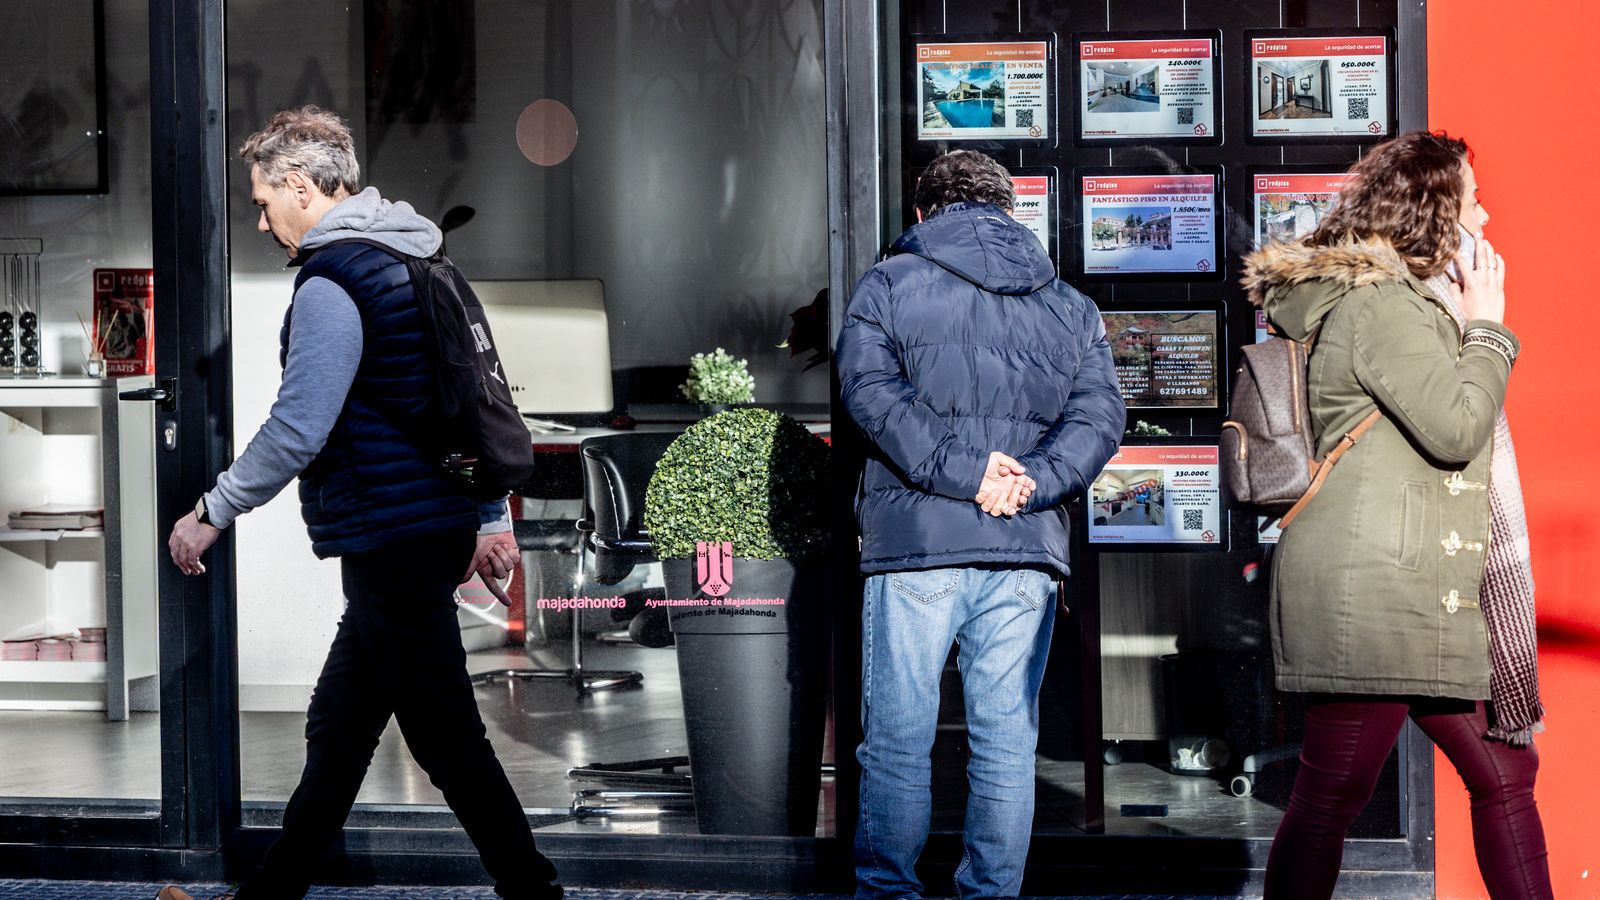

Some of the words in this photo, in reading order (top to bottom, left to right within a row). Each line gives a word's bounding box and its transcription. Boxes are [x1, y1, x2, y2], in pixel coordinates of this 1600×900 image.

[121, 274, 154, 286] redpis
[537, 596, 626, 612] majadahonda
[645, 598, 710, 608] Ayuntamiento
[724, 598, 785, 607] Majadahonda
